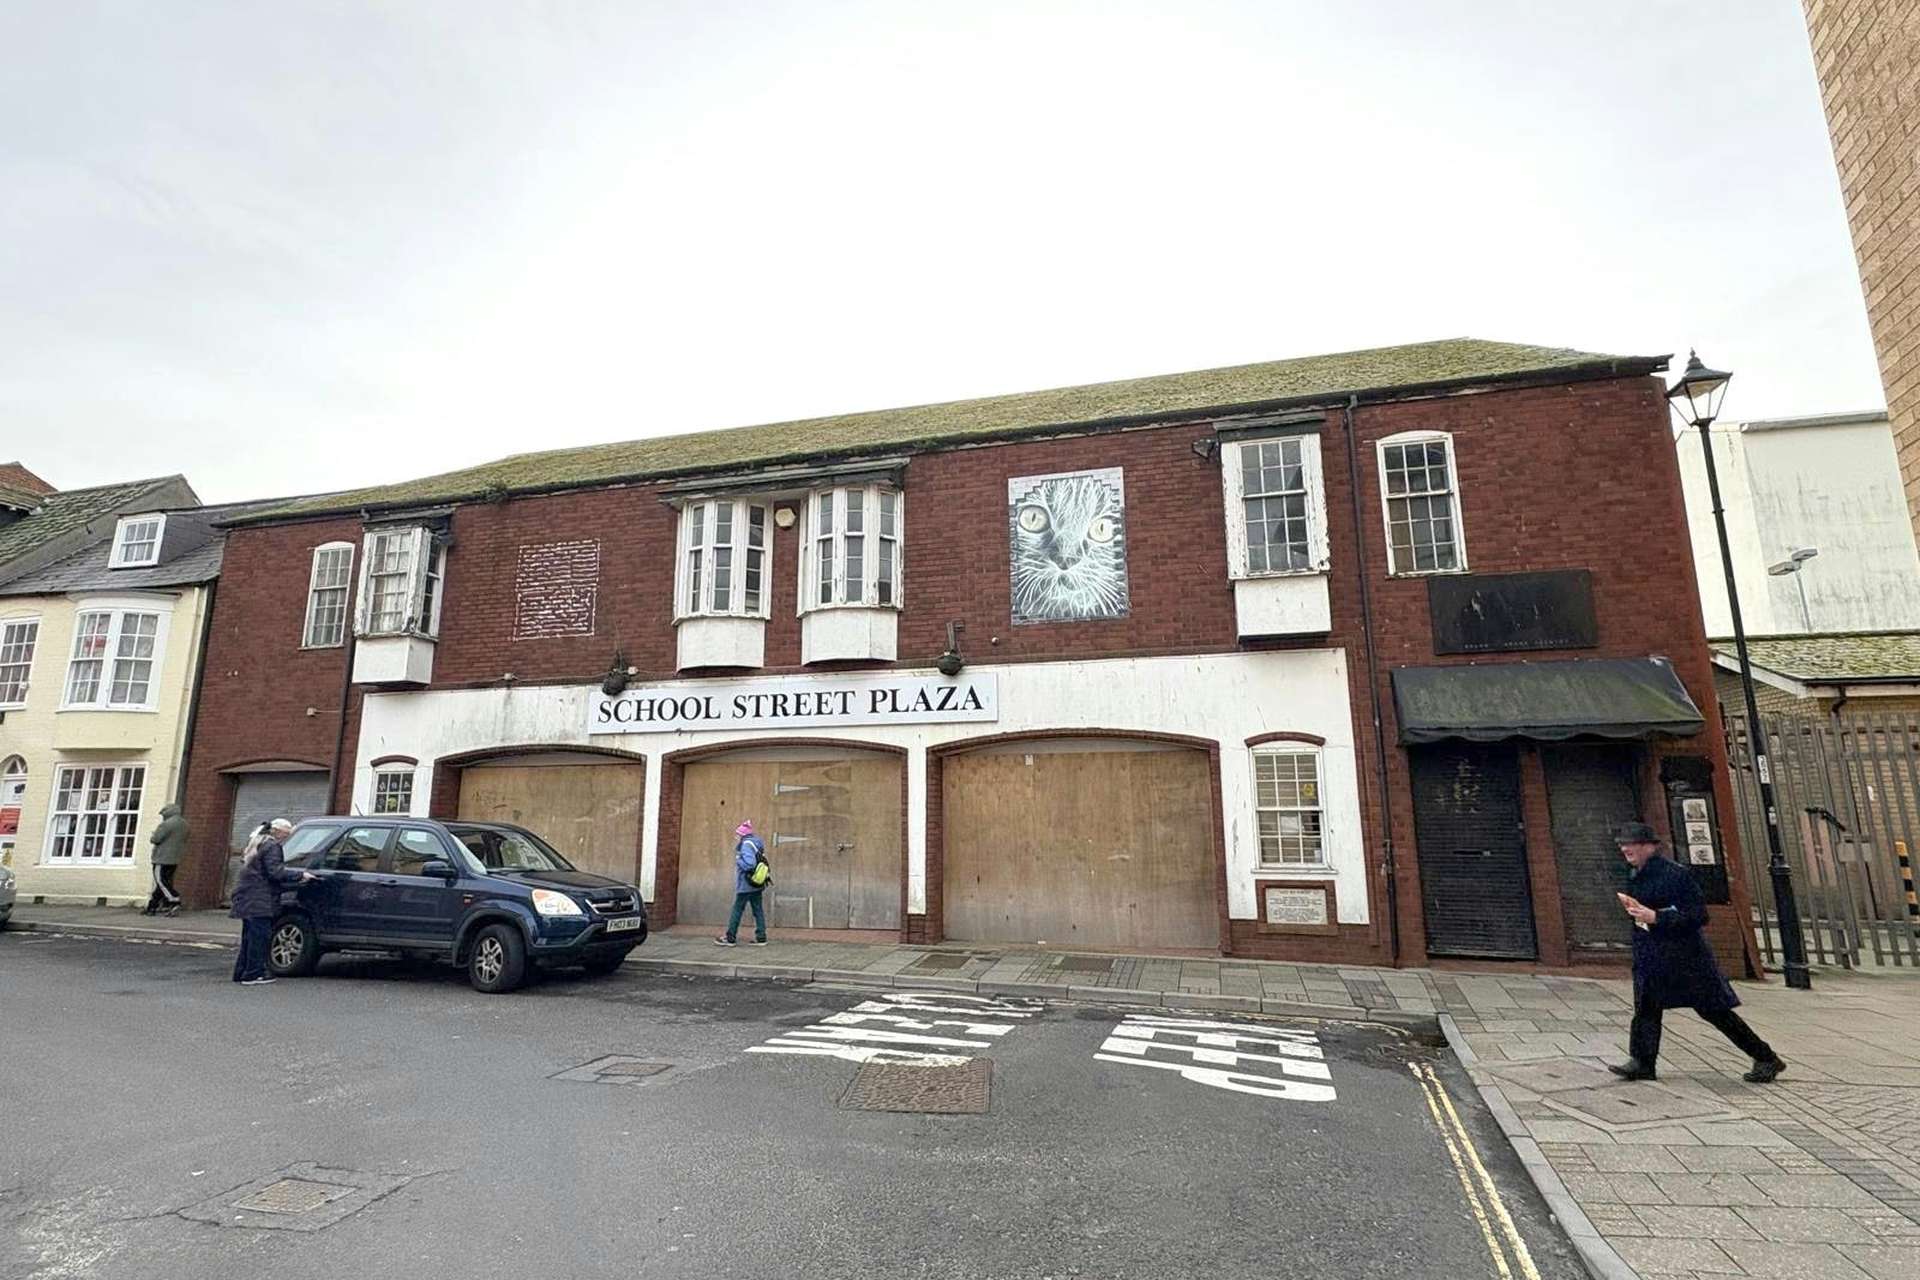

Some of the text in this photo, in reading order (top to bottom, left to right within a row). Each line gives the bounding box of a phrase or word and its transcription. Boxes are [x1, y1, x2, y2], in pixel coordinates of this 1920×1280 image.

[598, 685, 985, 723] SCHOOL STREET PLAZA
[745, 993, 1044, 1068] CLEAR
[1093, 1014, 1338, 1101] KEEP
